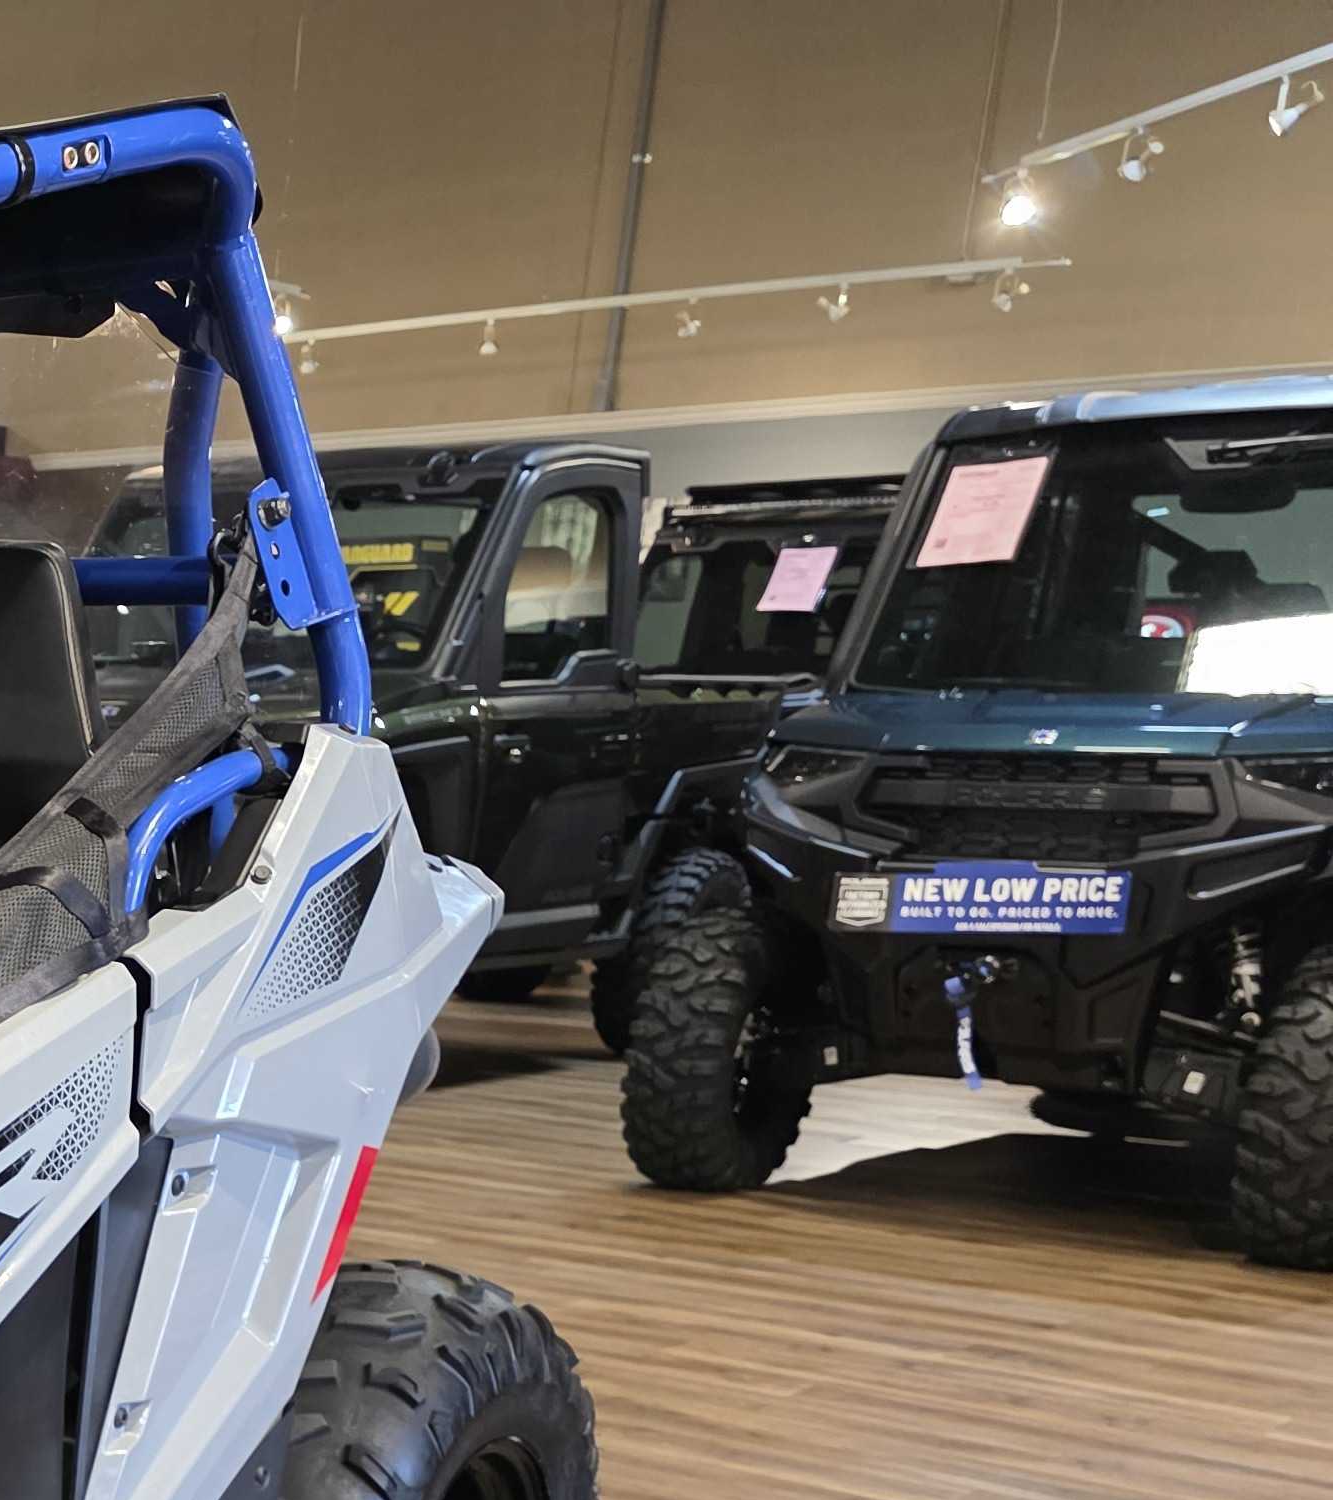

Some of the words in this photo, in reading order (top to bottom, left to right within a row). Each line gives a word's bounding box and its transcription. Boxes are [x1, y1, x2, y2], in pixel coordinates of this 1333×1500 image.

[903, 877, 969, 902] NEW
[973, 877, 1037, 902] LOW
[1041, 876, 1124, 902] PRICE
[900, 906, 942, 918] BUILT
[947, 906, 965, 918] TO
[969, 906, 993, 918] GO.
[997, 906, 1051, 918] PRICED
[1055, 906, 1074, 919] TO
[1076, 906, 1118, 919] MOVE.
